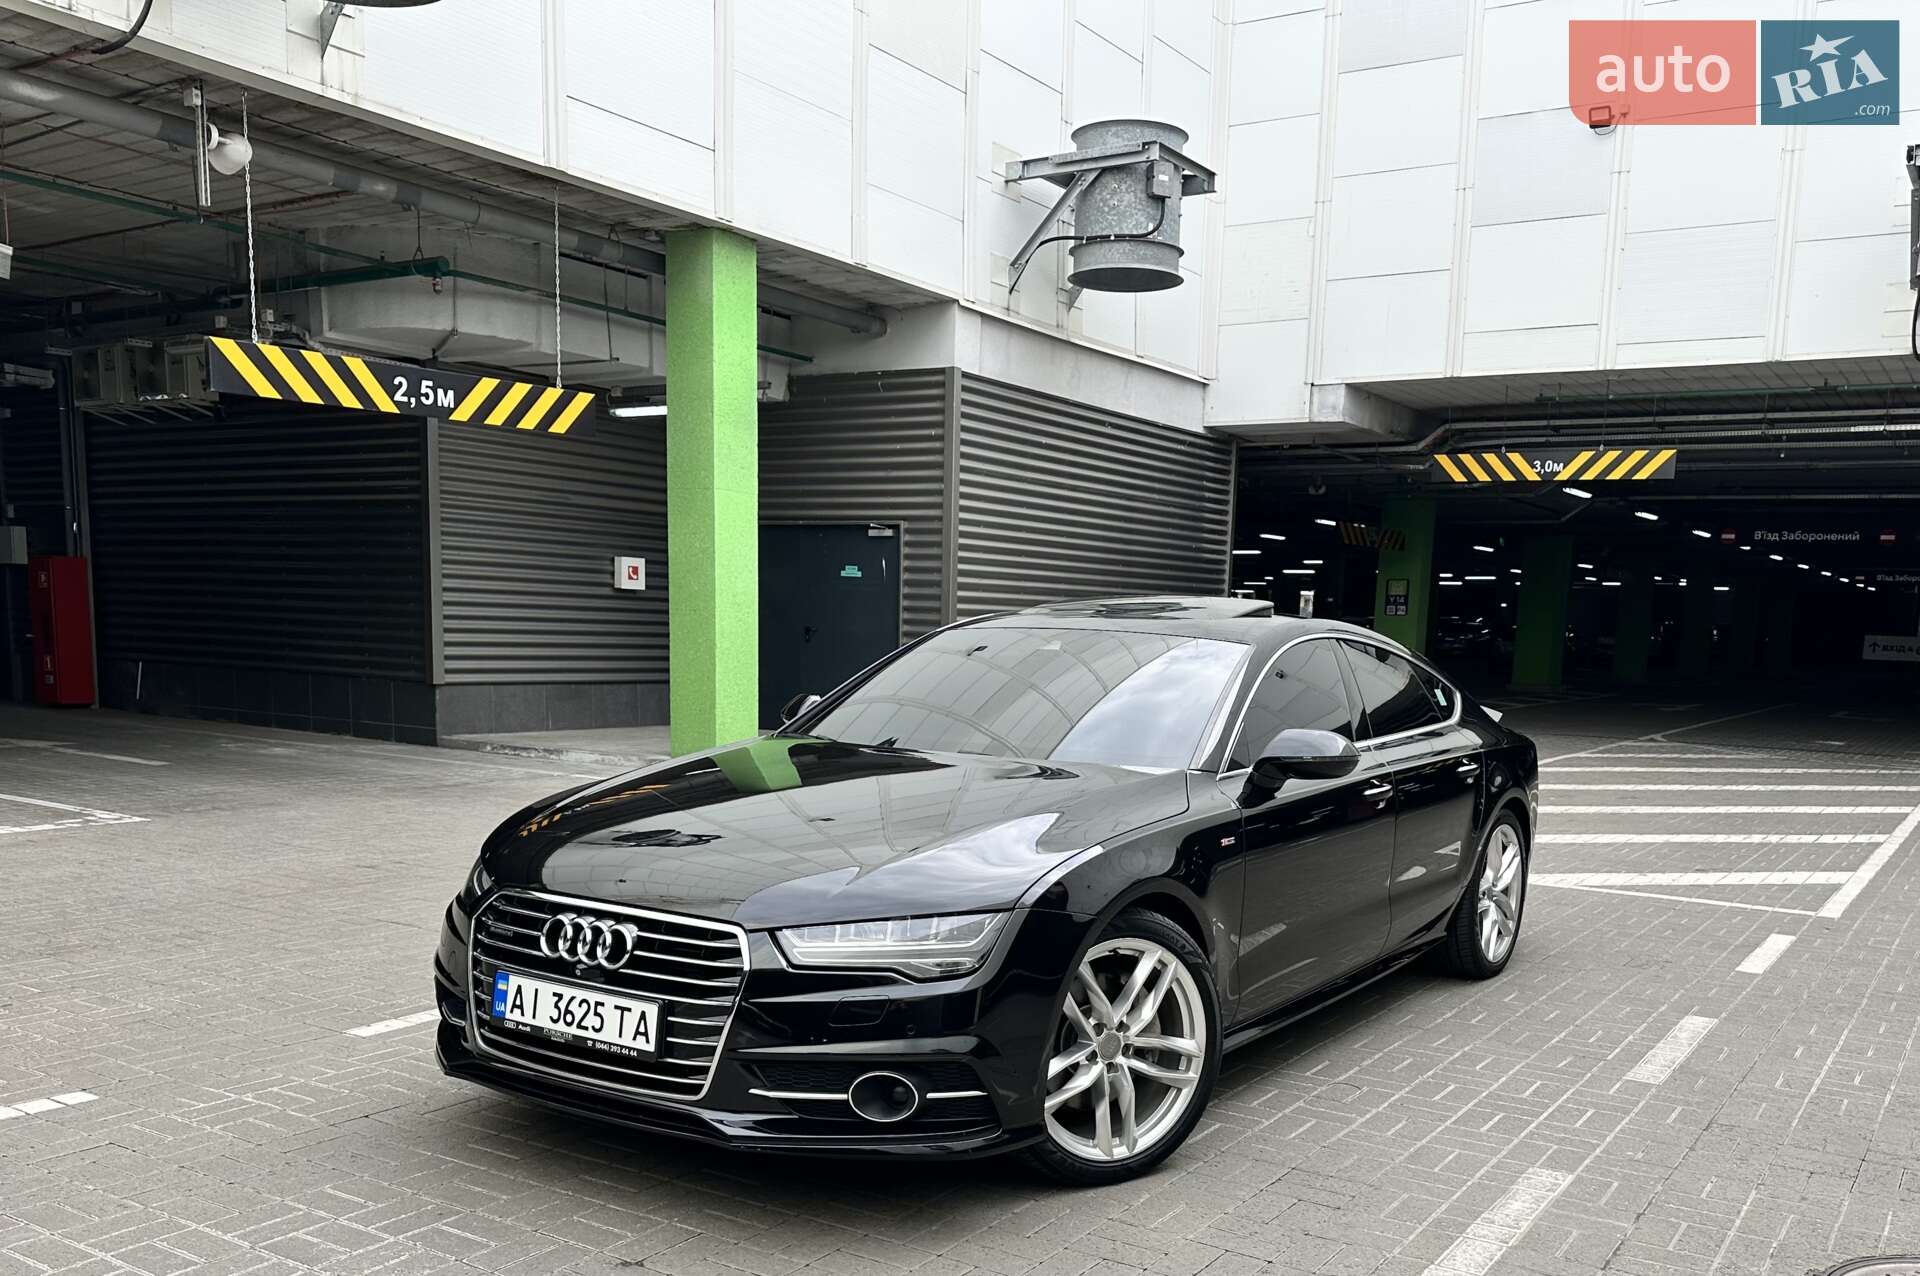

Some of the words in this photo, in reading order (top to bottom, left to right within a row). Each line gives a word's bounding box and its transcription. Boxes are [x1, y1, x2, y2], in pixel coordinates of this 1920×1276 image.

[1781, 530, 1860, 543] Заборонений
[495, 1000, 506, 1013] UA
[509, 984, 539, 1020] AI
[549, 991, 605, 1034] 3625
[614, 1005, 650, 1044] TA
